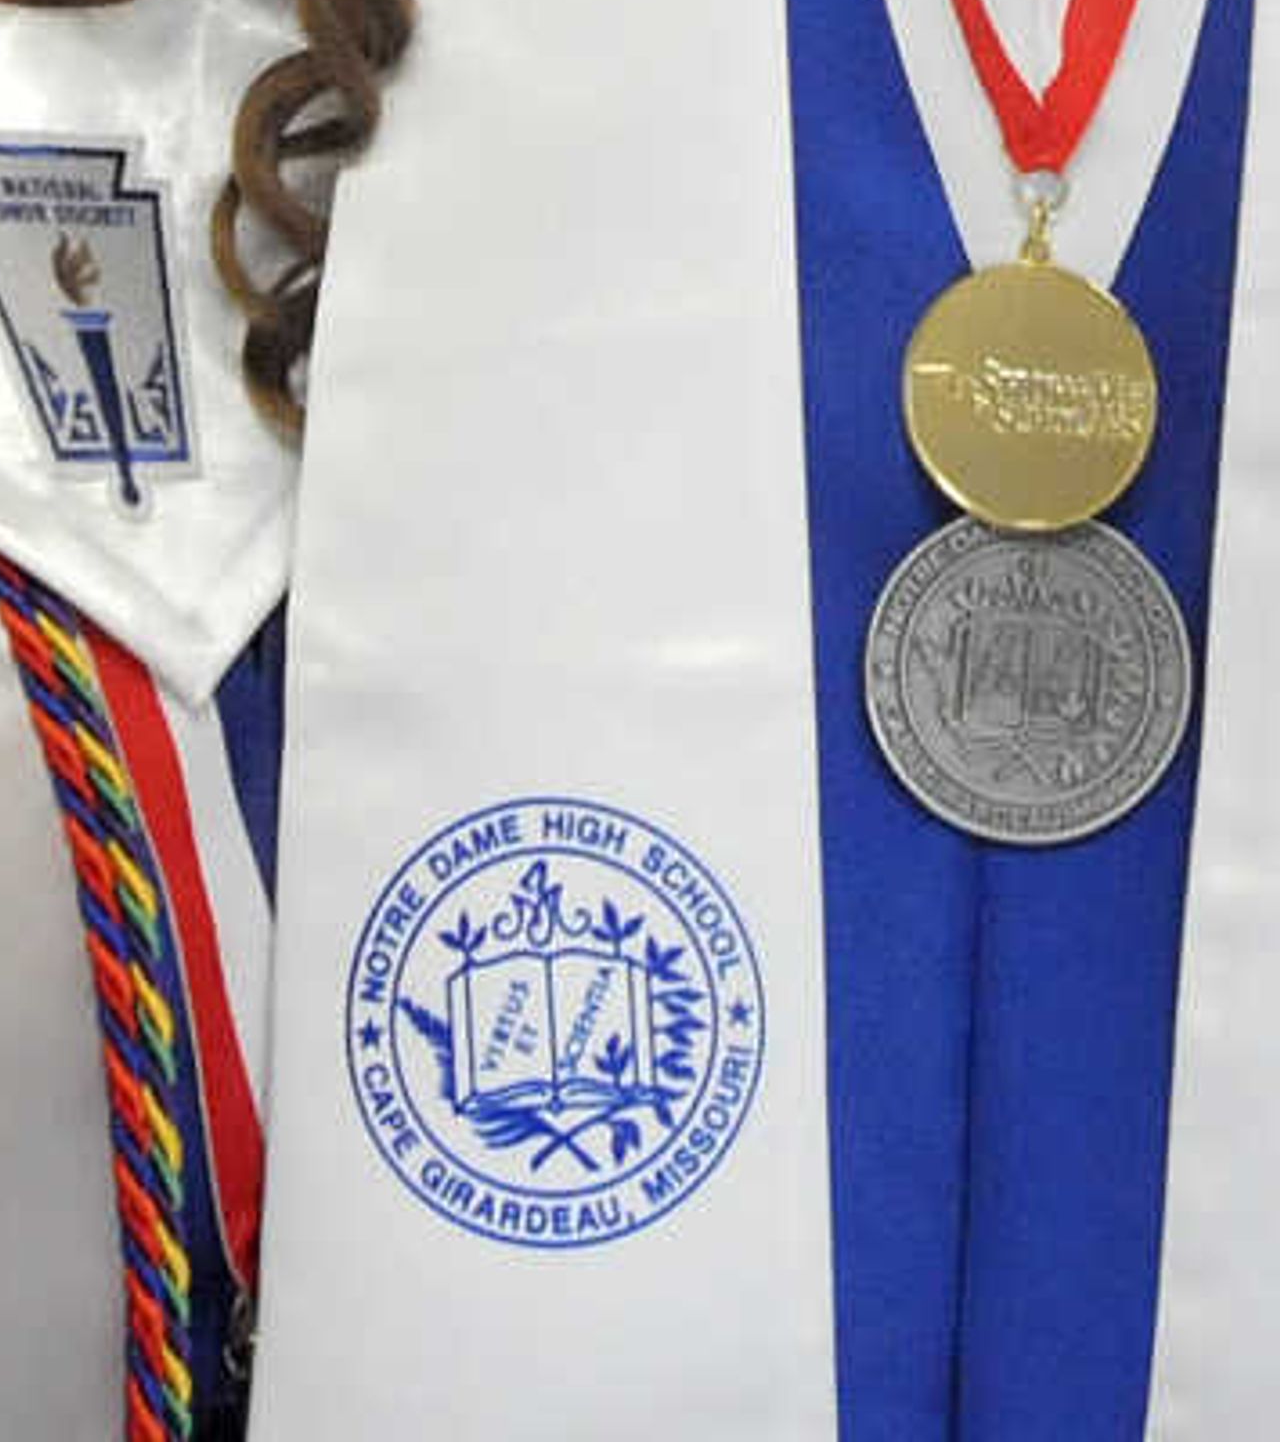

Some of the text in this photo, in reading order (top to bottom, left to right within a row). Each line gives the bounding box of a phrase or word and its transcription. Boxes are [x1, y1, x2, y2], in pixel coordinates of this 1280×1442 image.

[361, 810, 742, 1004] NOTRE DAME HIGH SCHOOL
[362, 1043, 753, 1237] CAPE GIRARDEAU, MISSOURI
